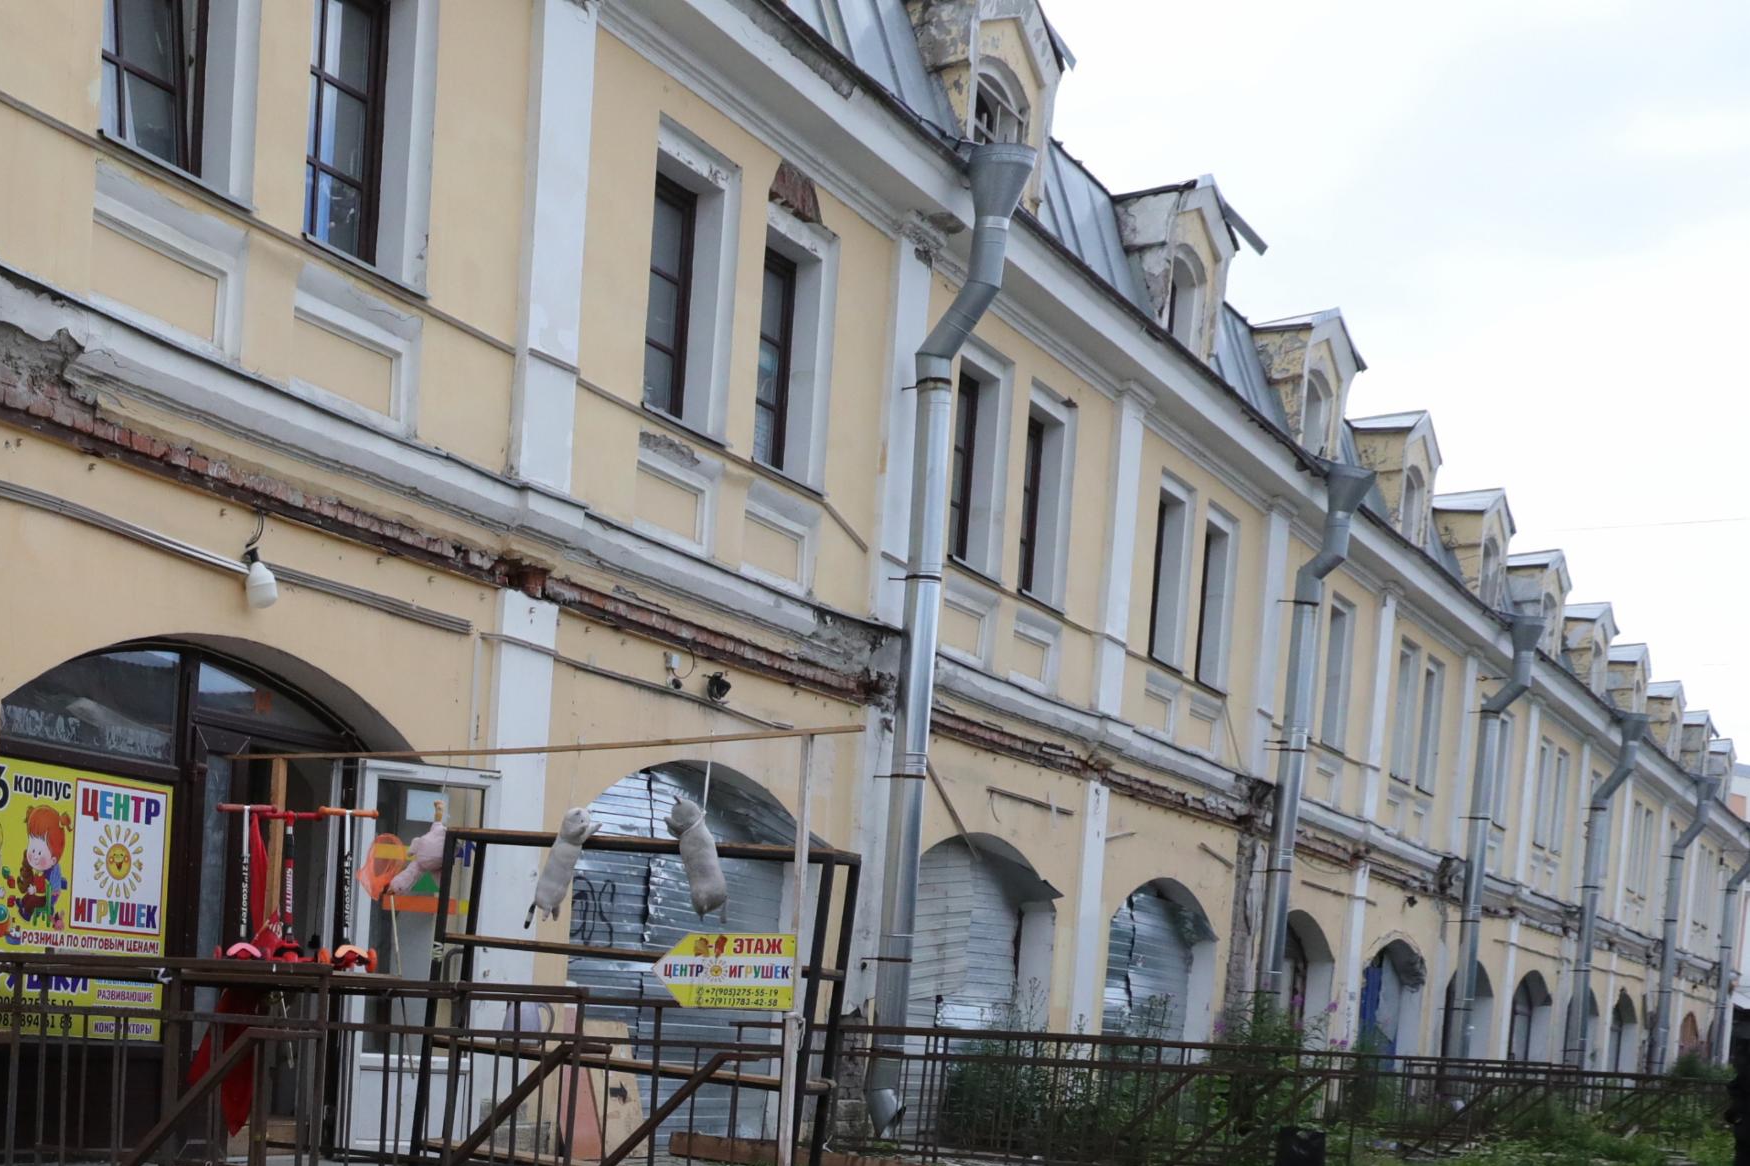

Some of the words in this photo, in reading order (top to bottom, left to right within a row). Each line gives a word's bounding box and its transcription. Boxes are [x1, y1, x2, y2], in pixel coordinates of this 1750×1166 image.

[13, 775, 72, 801] корпус
[81, 788, 161, 825] ЦЕНТР
[74, 897, 158, 928] ИГРУШЕК
[21, 931, 65, 947] РОЗНИЦА
[66, 935, 79, 948] ПО
[80, 936, 125, 951] ОПТОВЫМ
[126, 940, 159, 955] ЦЕНАМ!
[733, 938, 783, 954] ЭТАЖ
[664, 963, 704, 978] ЦЕНТР
[729, 964, 790, 979] ИГРУШЕК
[97, 989, 154, 1003] РАЗВИВАЮЩИЕ
